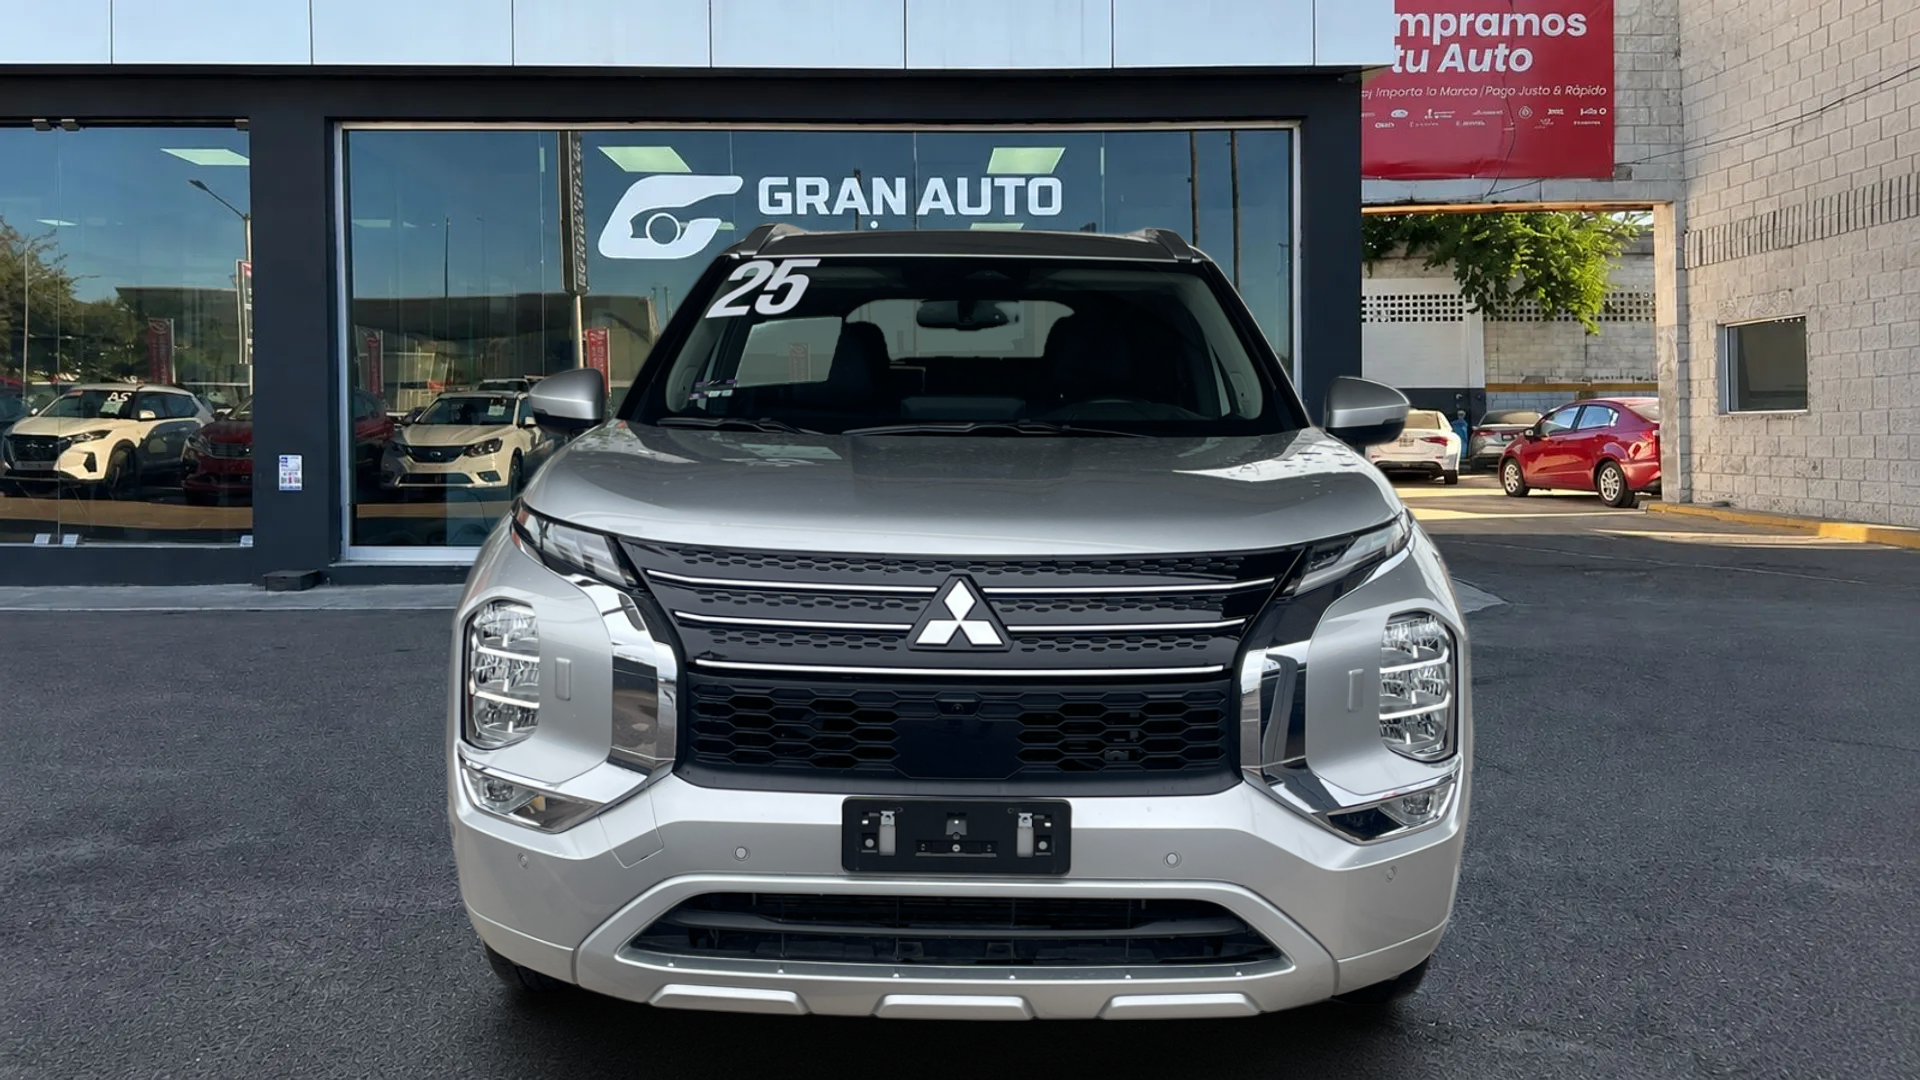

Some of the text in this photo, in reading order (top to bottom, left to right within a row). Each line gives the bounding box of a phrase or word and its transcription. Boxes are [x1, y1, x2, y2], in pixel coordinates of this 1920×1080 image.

[1391, 42, 1534, 73] tu Auto
[1376, 87, 1423, 100] Importa
[1426, 86, 1437, 97] la
[1439, 86, 1478, 97] Marca
[1518, 84, 1551, 96] Justo
[1553, 84, 1562, 96] &
[758, 176, 1062, 216] GRAN AUTO
[705, 258, 821, 319] 25
